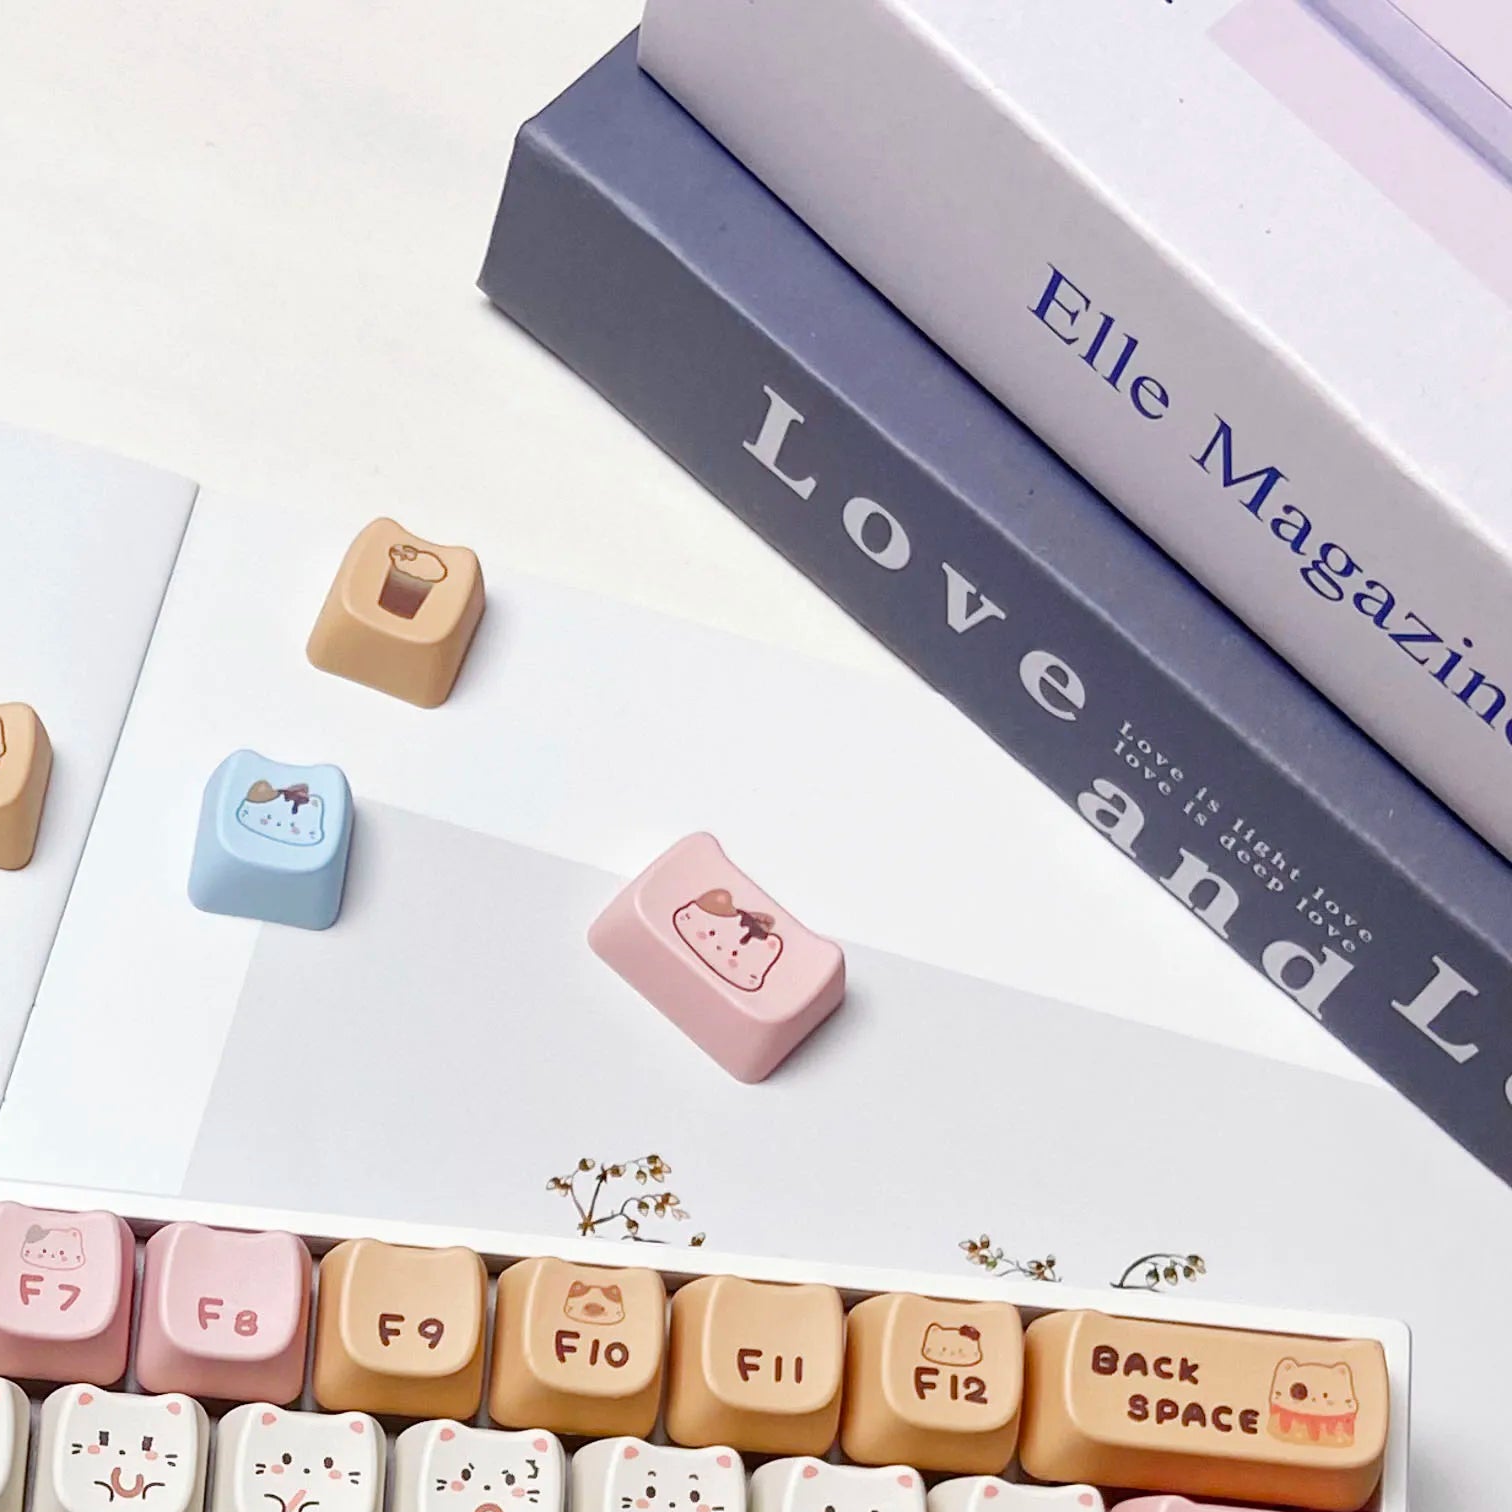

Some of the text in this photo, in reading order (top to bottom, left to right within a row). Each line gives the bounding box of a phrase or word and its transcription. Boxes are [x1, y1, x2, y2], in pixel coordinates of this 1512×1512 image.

[1027, 262, 1512, 747] Elle Magazin
[742, 385, 1512, 1105] Love and L
[1113, 740, 1356, 953] love is deep love
[1118, 720, 1372, 943] Love is light love
[20, 1274, 82, 1311] F7
[197, 1297, 258, 1336] F8
[378, 1314, 445, 1349] F9
[555, 1330, 629, 1368] F10
[737, 1348, 803, 1384] F11
[1091, 1344, 1200, 1385] BACK
[914, 1366, 988, 1404] F12
[1127, 1393, 1260, 1435] SPACE
[110, 1467, 144, 1499] U
